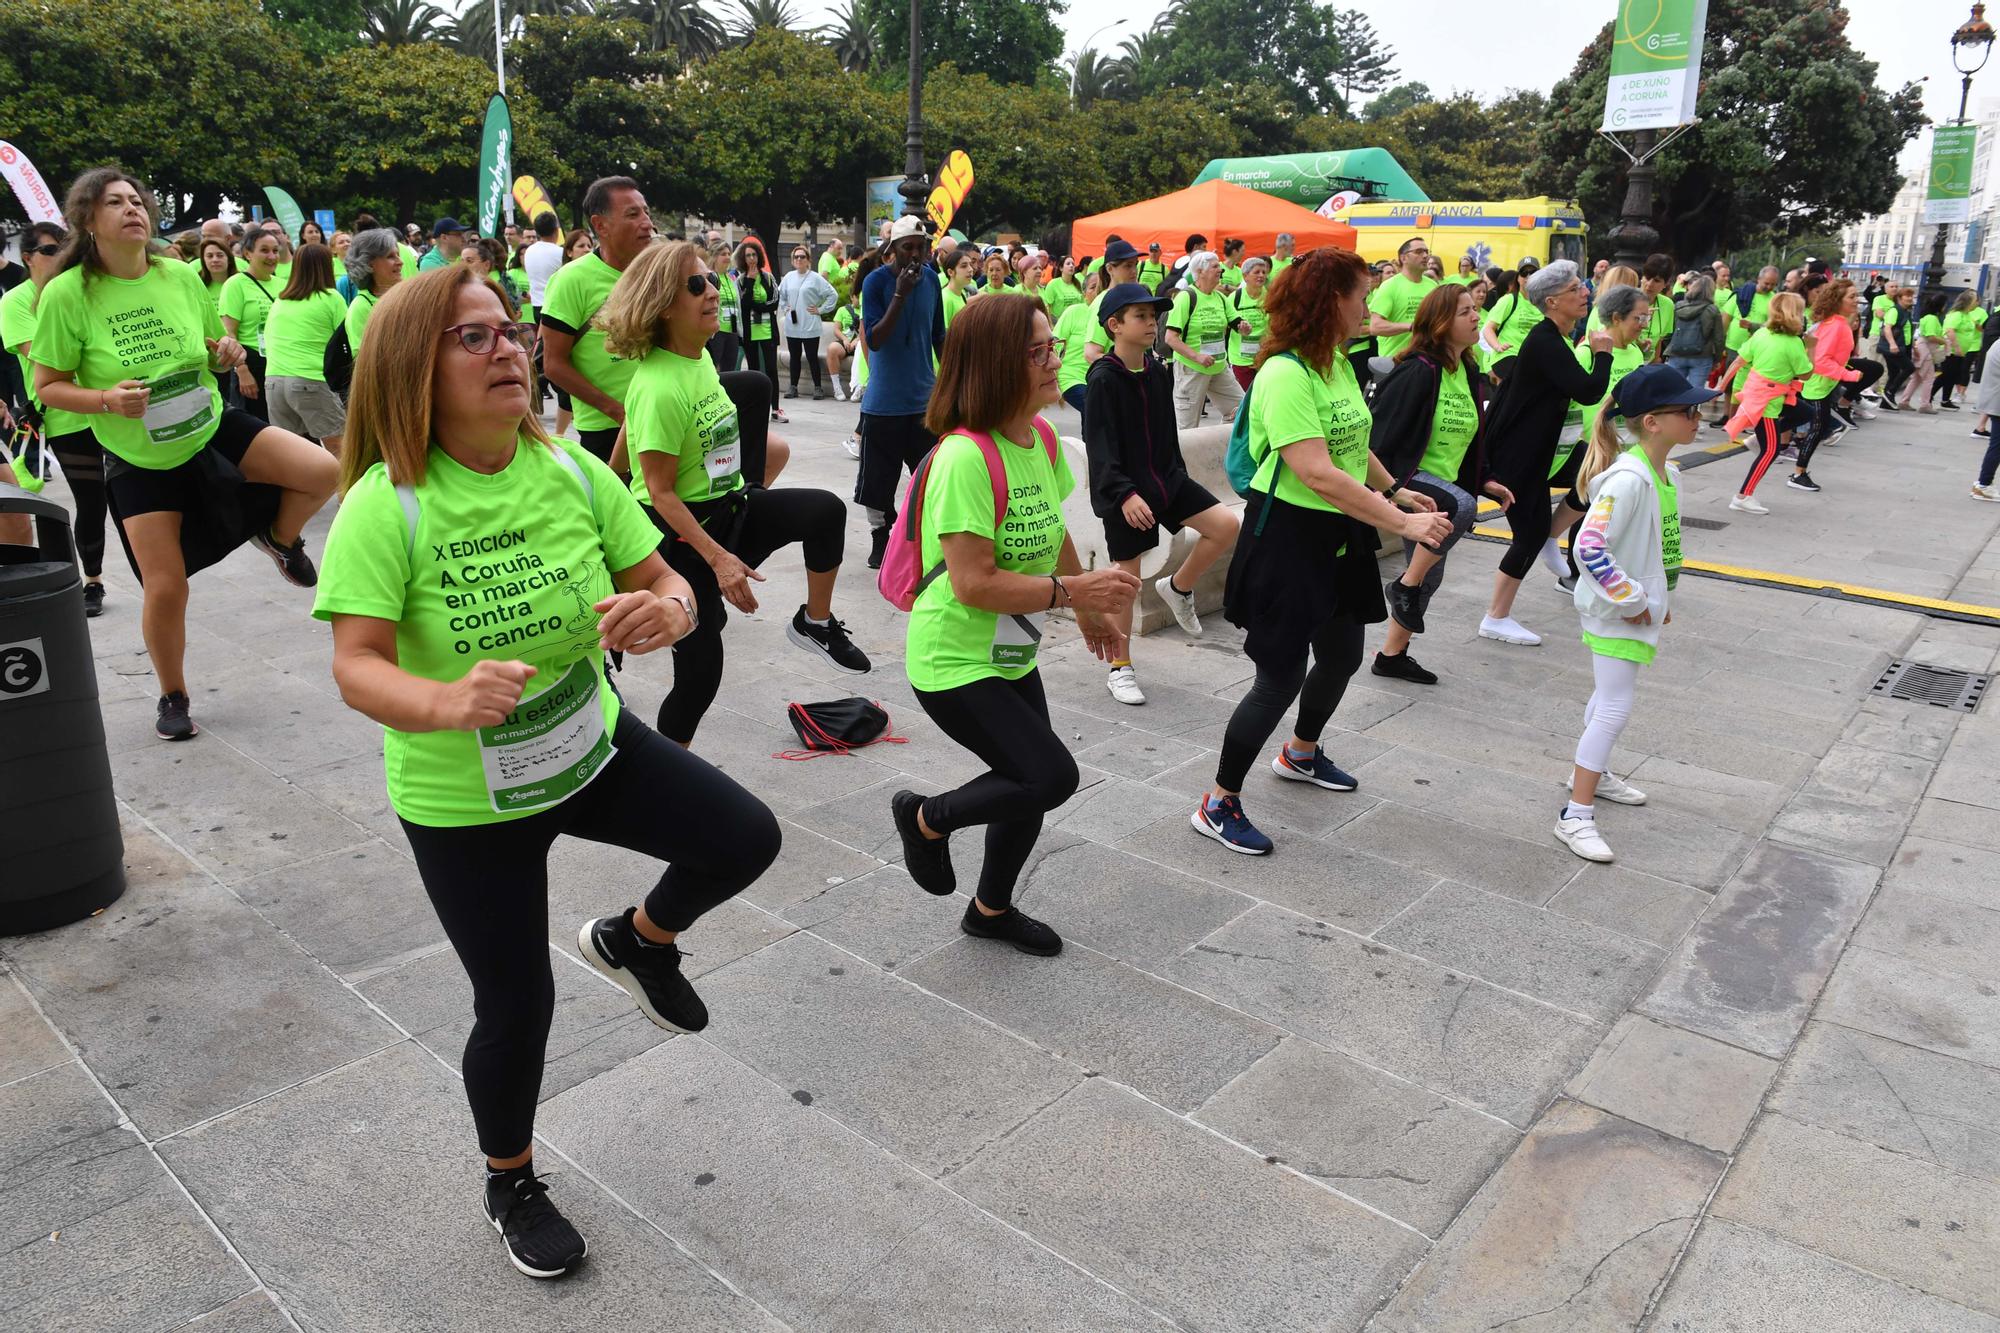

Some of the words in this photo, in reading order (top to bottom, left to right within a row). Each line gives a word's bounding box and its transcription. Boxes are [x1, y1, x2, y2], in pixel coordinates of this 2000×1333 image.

[1629, 80, 1641, 89] DE
[1223, 172, 1234, 180] En
[1235, 170, 1270, 180] marcha
[1261, 180, 1293, 188] cancro
[1390, 206, 1483, 216] AMBULANCIA
[106, 316, 114, 325] X
[115, 306, 155, 322] EDICIÓN
[112, 327, 120, 337] A
[121, 318, 164, 334] Coruña
[115, 338, 130, 347] en
[132, 326, 175, 343] marcha
[118, 342, 156, 357] contra
[133, 349, 172, 365] cancro
[692, 404, 699, 414] X
[696, 418, 704, 427] A
[1331, 413, 1339, 424] A
[1331, 427, 1345, 435] en
[1348, 418, 1368, 432] marcha
[1329, 434, 1356, 446] contra
[1007, 507, 1016, 517] A
[1020, 500, 1050, 517] Coruña
[1005, 522, 1025, 533] en
[1028, 513, 1060, 531] marcha
[432, 545, 447, 562] X
[449, 529, 526, 559] EDICIÓN
[1004, 533, 1047, 547] contra
[1002, 552, 1013, 561] o
[1017, 545, 1053, 561] cancro
[440, 570, 458, 589] A
[461, 552, 544, 584] Coruña
[445, 592, 476, 609] en
[482, 566, 569, 602] marcha
[449, 601, 533, 632] contra
[454, 640, 471, 655] o
[478, 615, 562, 650] cancro
[526, 684, 575, 722] estou
[494, 732, 507, 741] en
[510, 722, 546, 738] marcha
[547, 705, 571, 725] contra
[577, 682, 594, 703] cancro
[506, 788, 546, 801] Vegalsa
